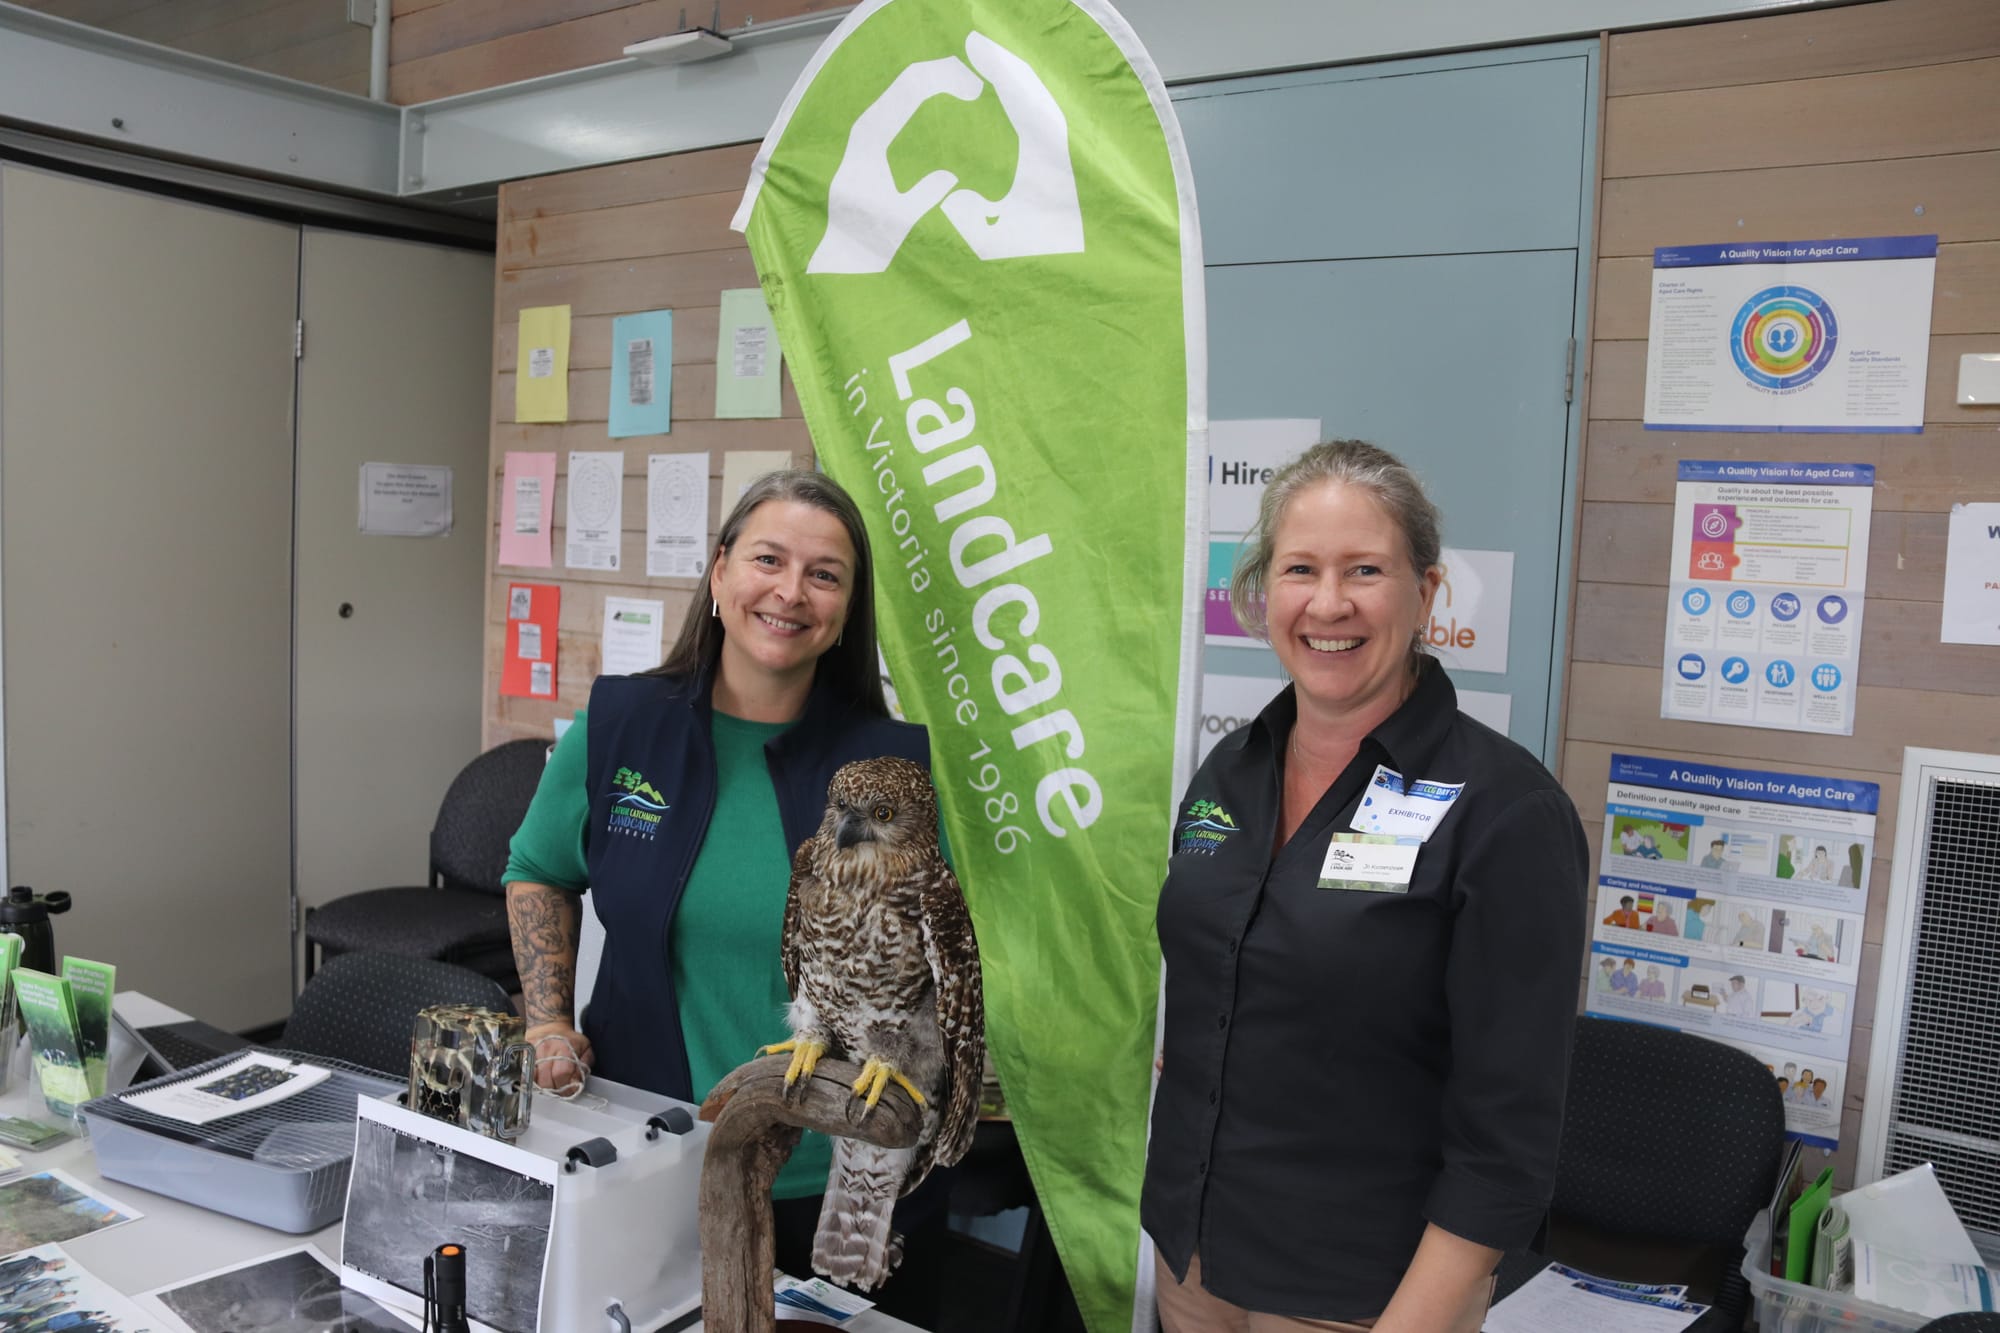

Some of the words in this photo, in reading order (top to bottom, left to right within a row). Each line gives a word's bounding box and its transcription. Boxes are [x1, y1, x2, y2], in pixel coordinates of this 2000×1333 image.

[1720, 250, 1727, 259] A
[1728, 248, 1760, 259] Quality
[1763, 248, 1791, 257] Vision
[1793, 247, 1807, 256] for
[1808, 246, 1833, 258] Aged
[1836, 246, 1859, 255] Care
[1718, 466, 1725, 474] A
[1727, 466, 1758, 477] Quality
[1760, 467, 1788, 476] Vision
[1790, 468, 1803, 476] for
[1805, 468, 1830, 478] Aged
[1832, 469, 1855, 478] Care
[1718, 486, 1741, 494] Quality
[1802, 489, 1833, 497] possible
[888, 319, 1103, 838] Landcare
[844, 366, 867, 416] in
[865, 416, 930, 593] Victoria
[925, 607, 979, 726] since
[967, 738, 1032, 855] 1986
[1669, 769, 1679, 780] A
[1681, 771, 1723, 789] Quality
[1726, 776, 1763, 792] Vision
[1767, 781, 1785, 793] for
[1787, 783, 1821, 798] Aged
[1824, 788, 1855, 801] Care
[1617, 790, 1656, 803] Definition
[1659, 794, 1667, 803] of
[1669, 796, 1697, 809] quality
[1699, 801, 1720, 813] aged
[1722, 805, 1741, 815] care
[1388, 807, 1432, 822] EXHIBITOR
[1629, 808, 1641, 816] and
[1607, 878, 1627, 889] Caring
[1628, 881, 1640, 889] and
